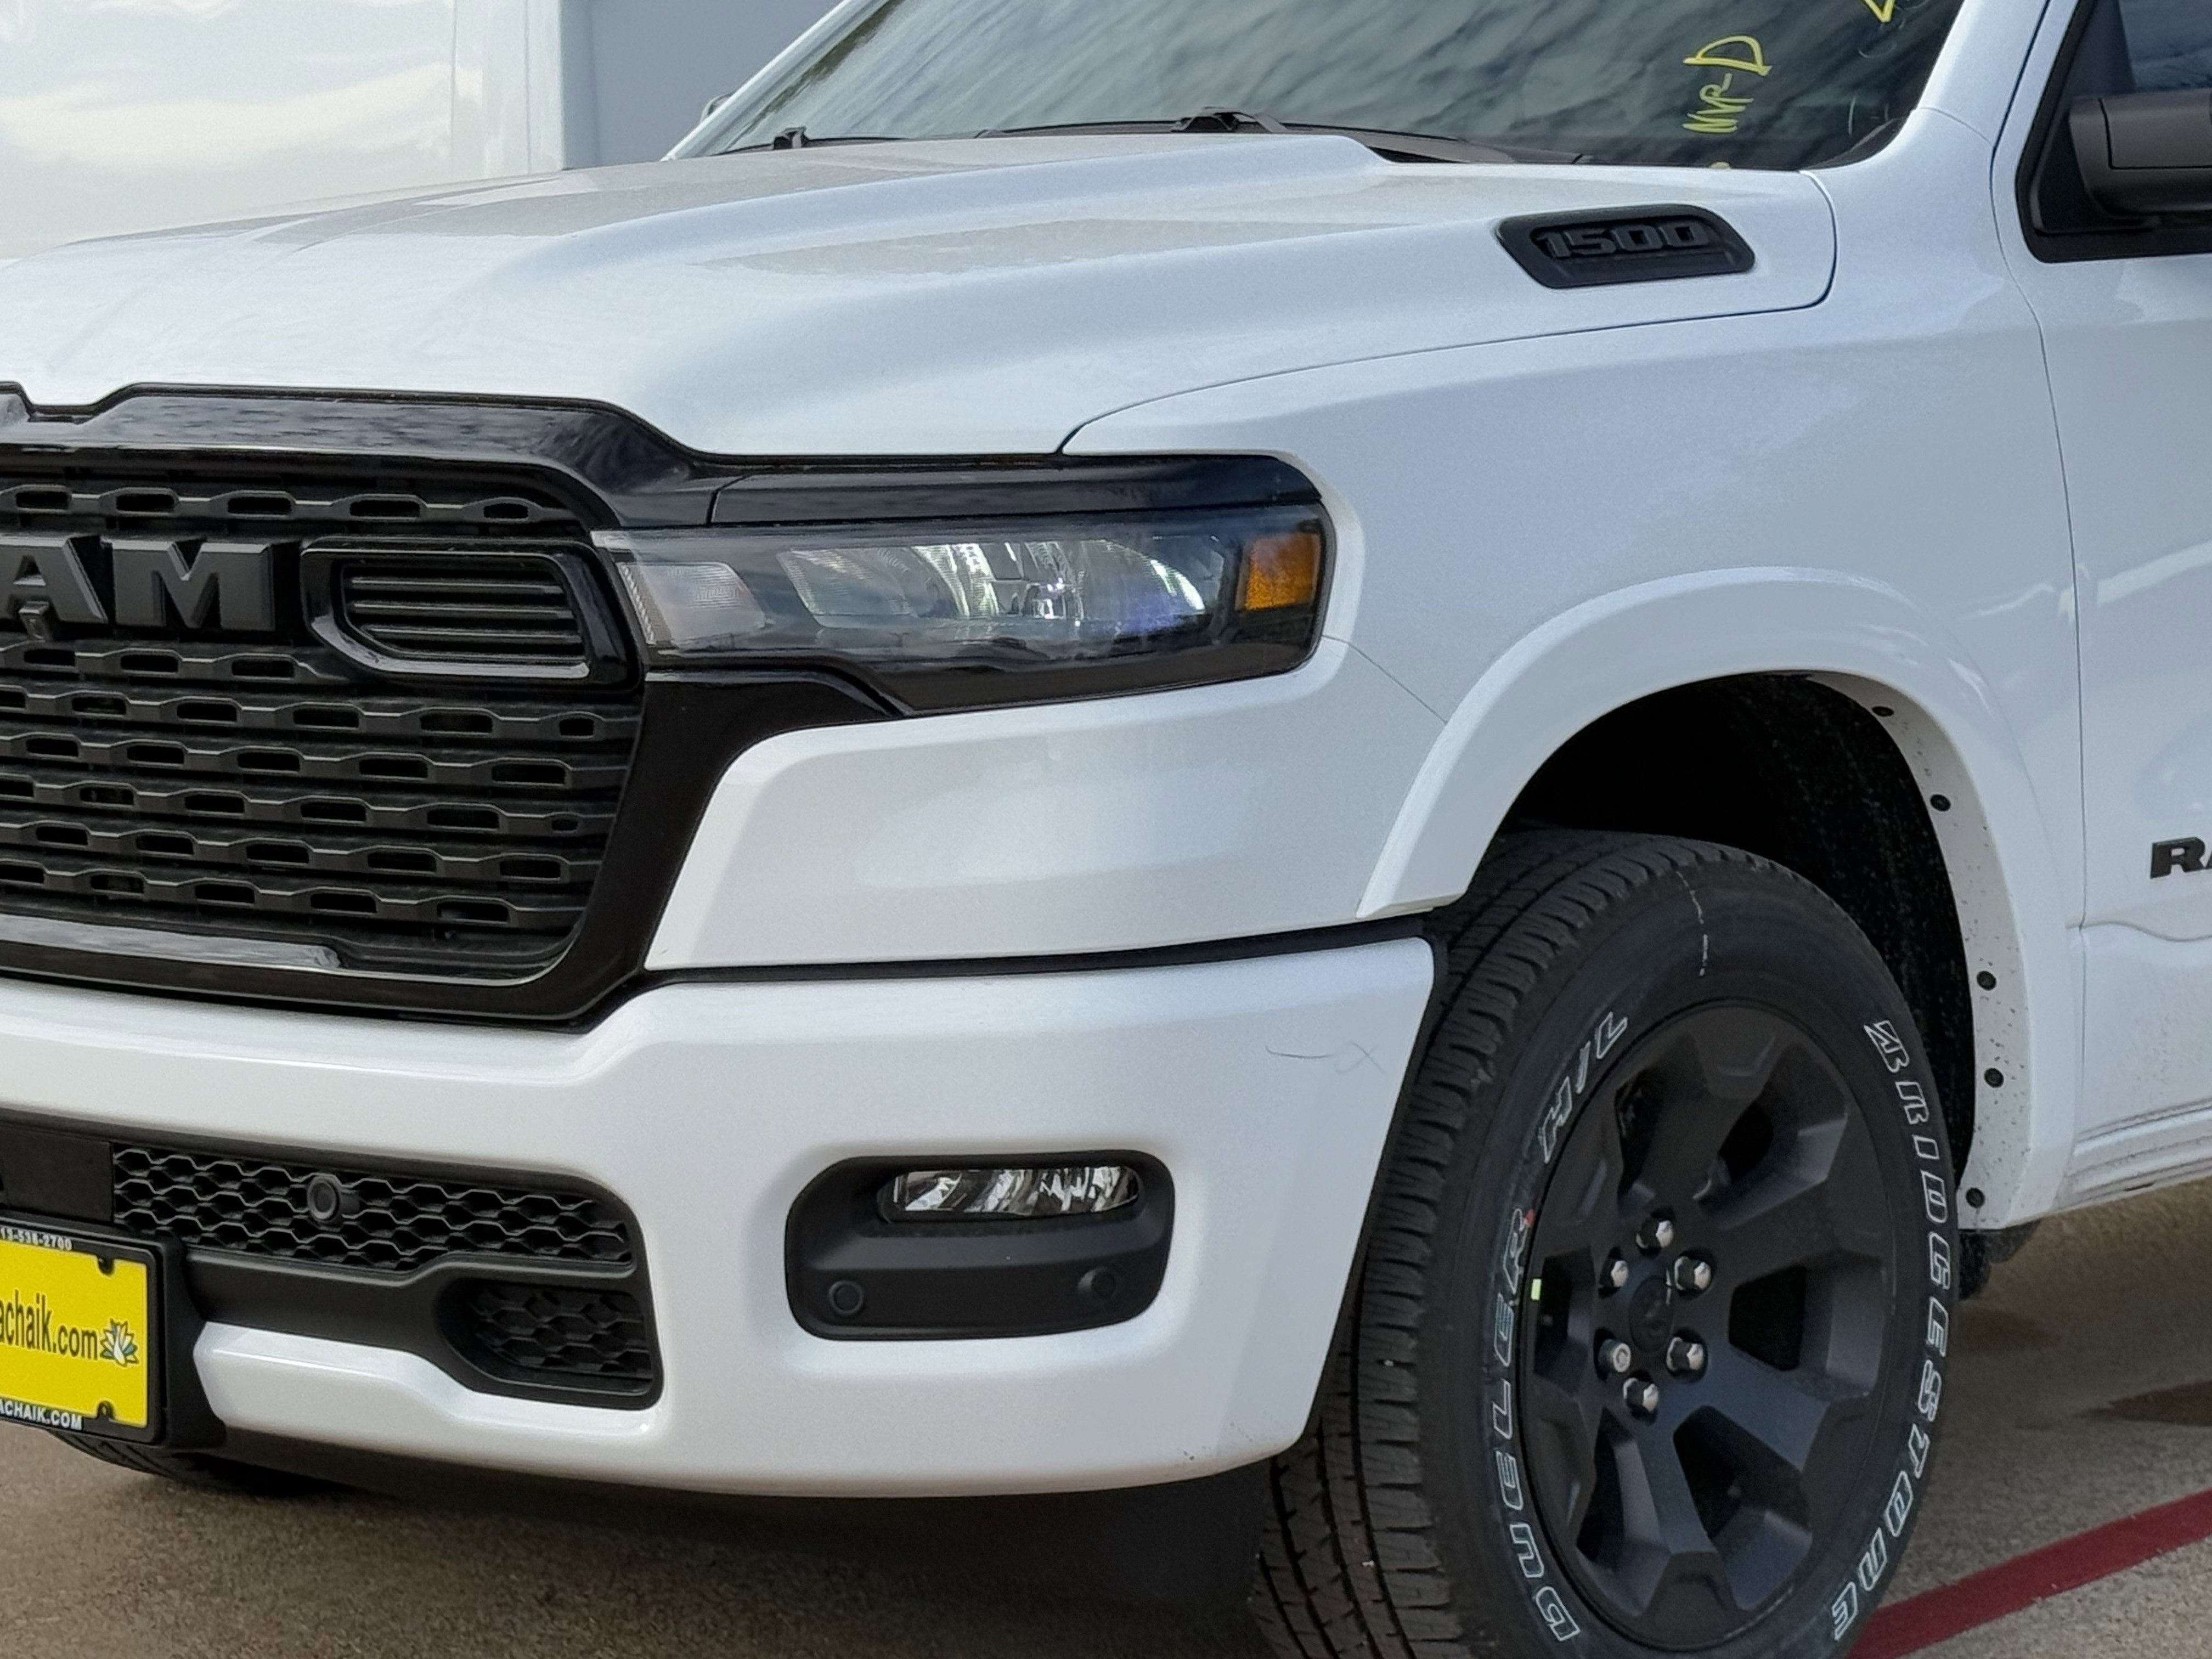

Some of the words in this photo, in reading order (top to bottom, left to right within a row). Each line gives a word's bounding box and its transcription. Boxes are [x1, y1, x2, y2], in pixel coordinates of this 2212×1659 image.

[1537, 222, 1709, 259] 1500
[2150, 837, 2212, 879] R
[1492, 1207, 1581, 1641] DUELER
[1831, 1020, 1951, 1641] BRIDGESTONE
